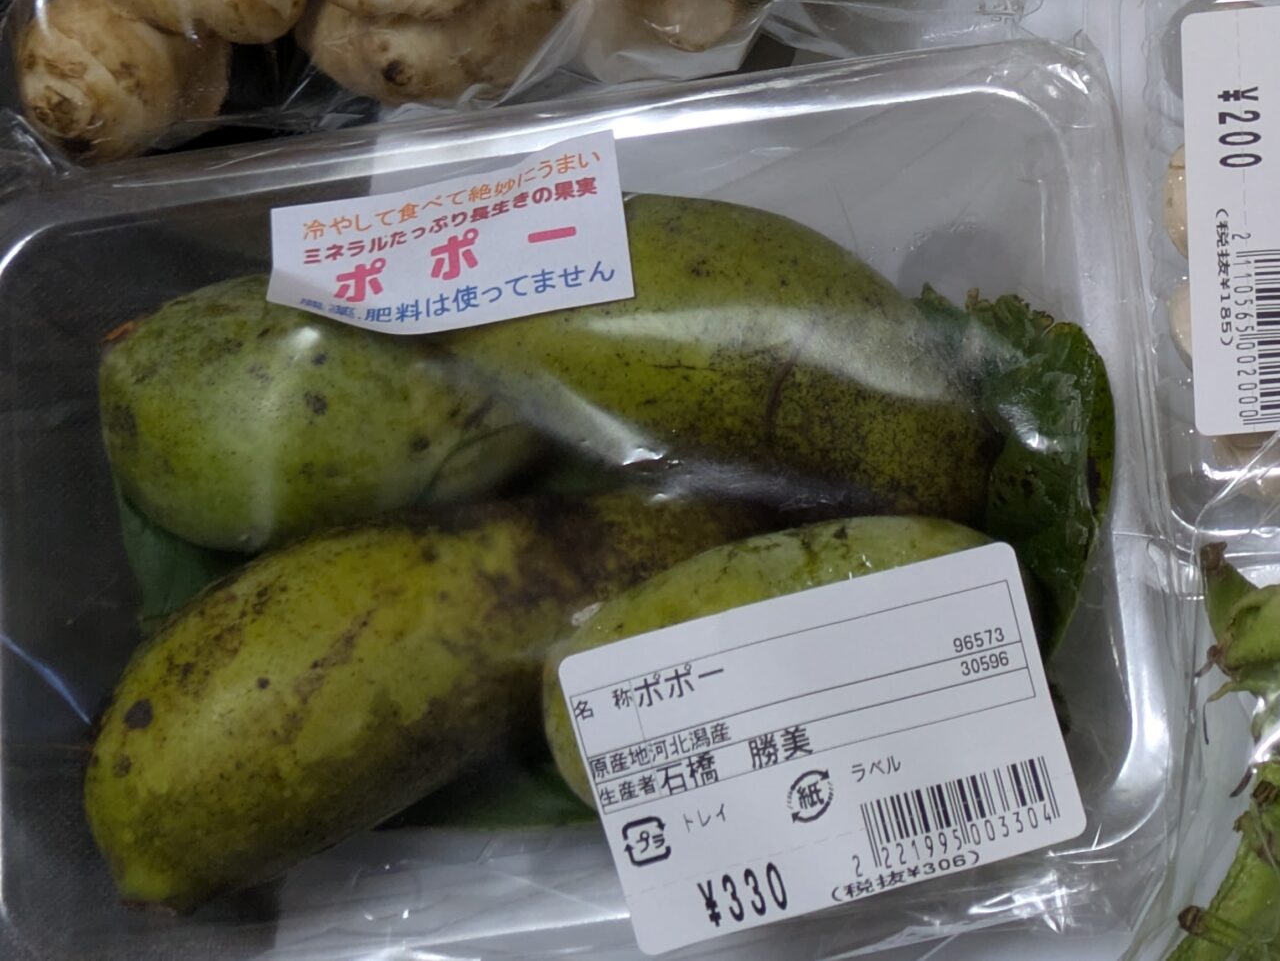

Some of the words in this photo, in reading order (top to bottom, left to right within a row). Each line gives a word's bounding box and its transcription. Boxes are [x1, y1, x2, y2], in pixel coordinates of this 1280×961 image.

[1217, 85, 1263, 168] ¥200
[303, 149, 601, 240] 冷やして食べて絶妙にうまい
[303, 176, 598, 264] ミネラルたっぷり長生きの果実
[334, 225, 577, 304] ポポー
[953, 627, 1006, 654] 96573
[960, 651, 1010, 677] 30596
[633, 662, 725, 709] ポポー
[797, 781, 825, 811] 紙
[851, 755, 902, 783] ラベル
[682, 803, 727, 834] トレイ
[697, 861, 788, 927] ¥330
